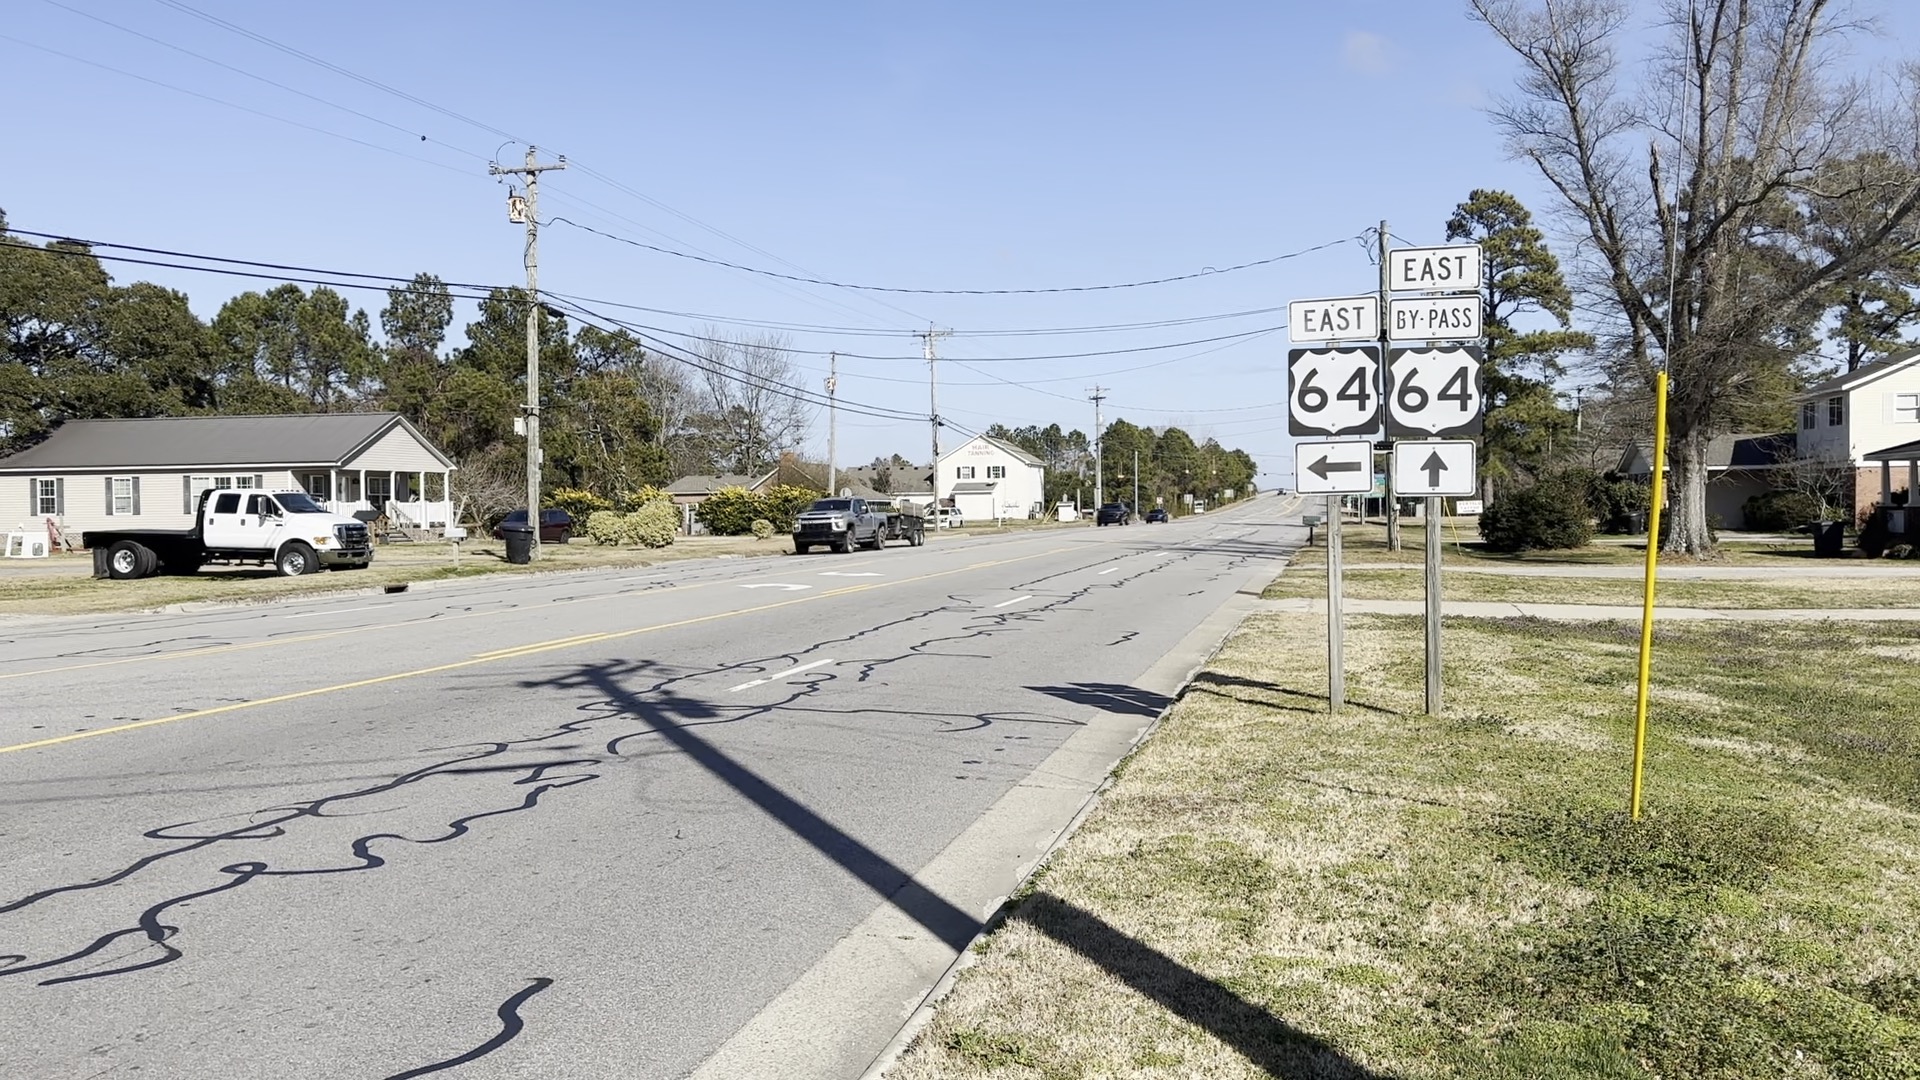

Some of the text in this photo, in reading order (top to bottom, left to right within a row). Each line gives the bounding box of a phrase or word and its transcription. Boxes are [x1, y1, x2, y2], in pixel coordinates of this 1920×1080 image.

[1404, 256, 1467, 282] EAST
[1304, 306, 1365, 332] EAST
[1397, 308, 1472, 329] BY-PASS
[1297, 366, 1371, 413] 64
[1397, 366, 1473, 413] 64
